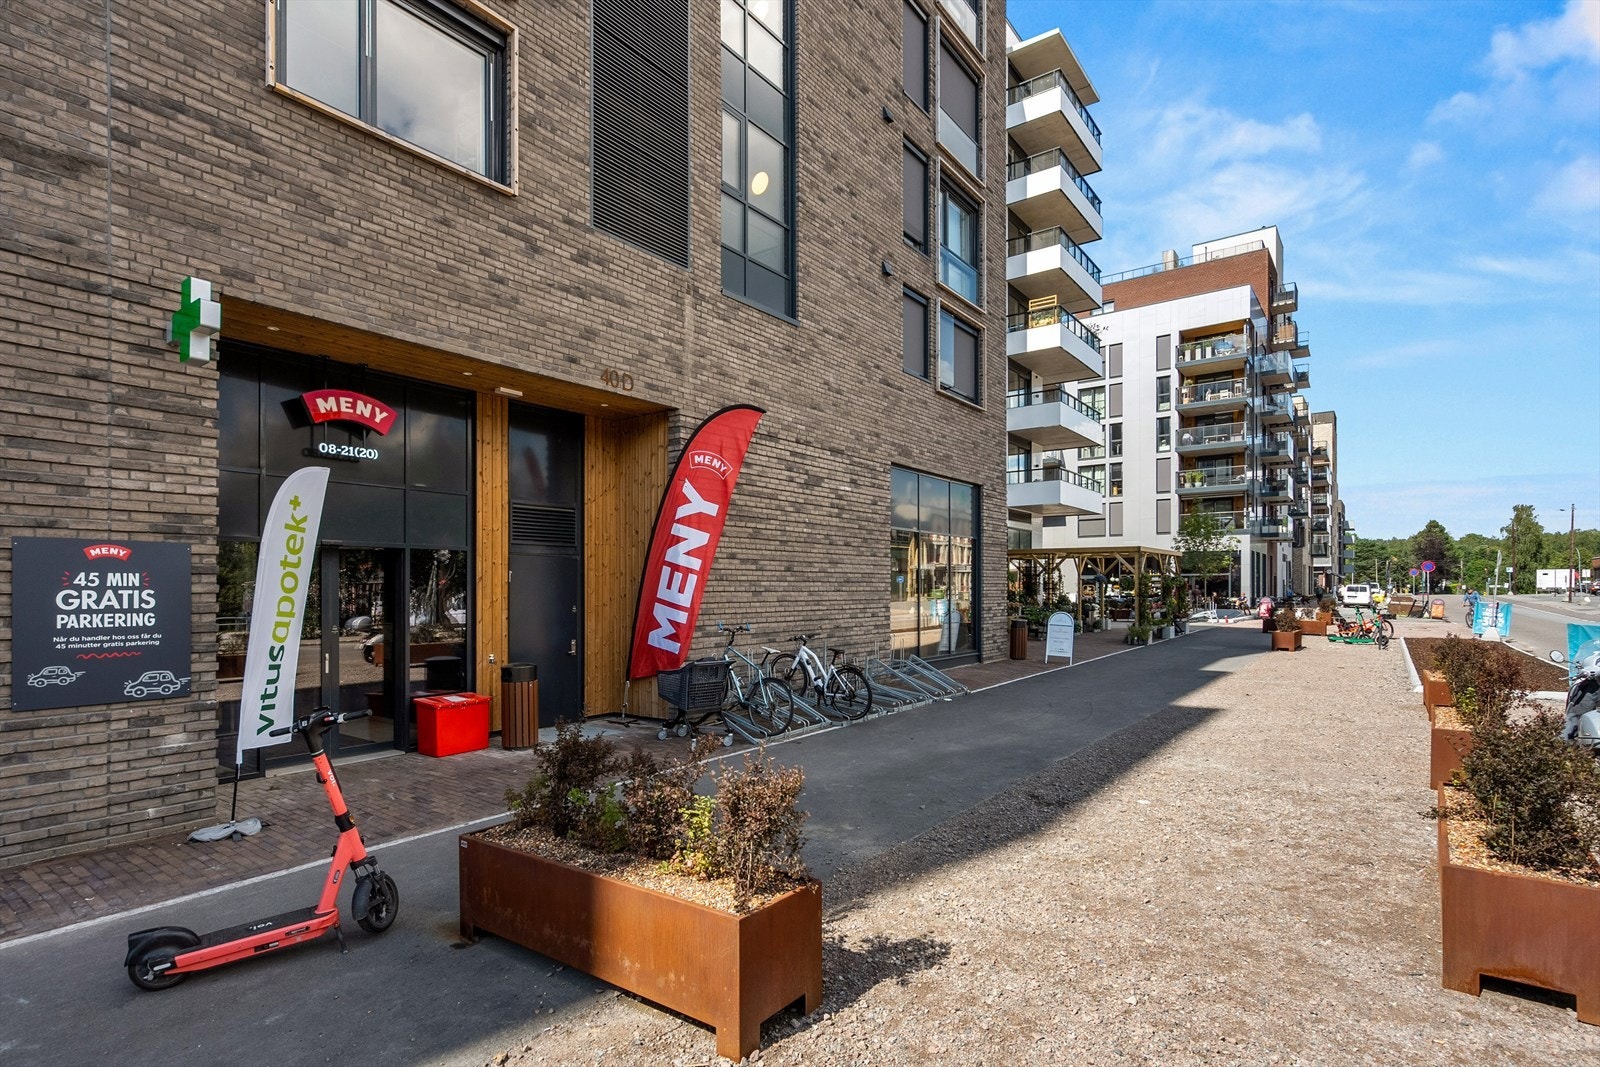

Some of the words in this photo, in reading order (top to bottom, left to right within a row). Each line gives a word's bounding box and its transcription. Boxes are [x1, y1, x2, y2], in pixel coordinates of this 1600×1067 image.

[315, 396, 389, 424] MENY
[318, 442, 379, 460] 08-21(20)
[694, 454, 727, 472] MENY
[89, 547, 128, 557] MENY
[647, 478, 720, 655] MENY
[73, 572, 100, 587] 45
[106, 572, 140, 587] MIN
[55, 589, 156, 610] GRATIS
[56, 612, 156, 629] PARKERING
[53, 635, 67, 643] Når
[81, 634, 110, 642] handler
[68, 641, 101, 649] minutter
[103, 640, 124, 648] gratis
[125, 639, 160, 647] parkering
